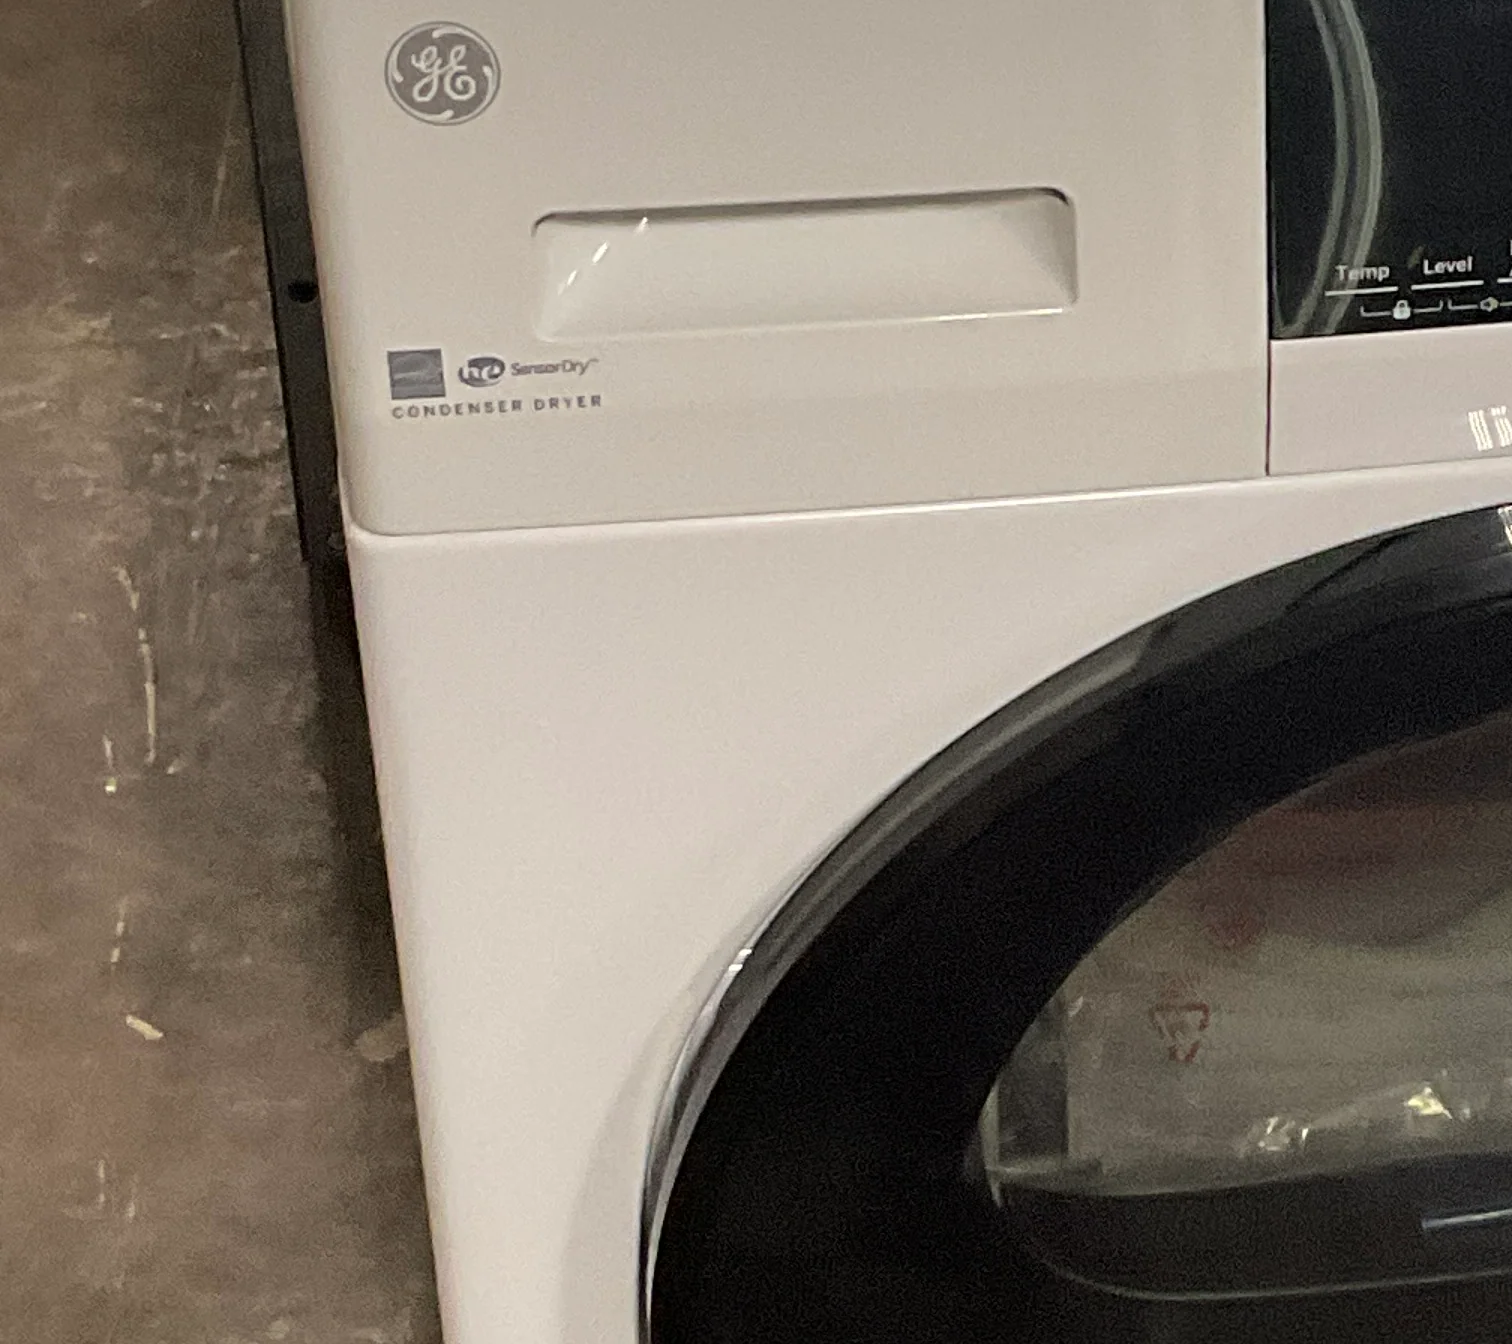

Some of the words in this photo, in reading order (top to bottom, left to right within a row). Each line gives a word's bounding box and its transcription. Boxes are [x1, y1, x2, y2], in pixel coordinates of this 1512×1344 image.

[1335, 264, 1390, 282] Temp
[1423, 256, 1474, 276] Level
[391, 399, 522, 420] CONDENSER
[534, 395, 602, 412] DRYER
